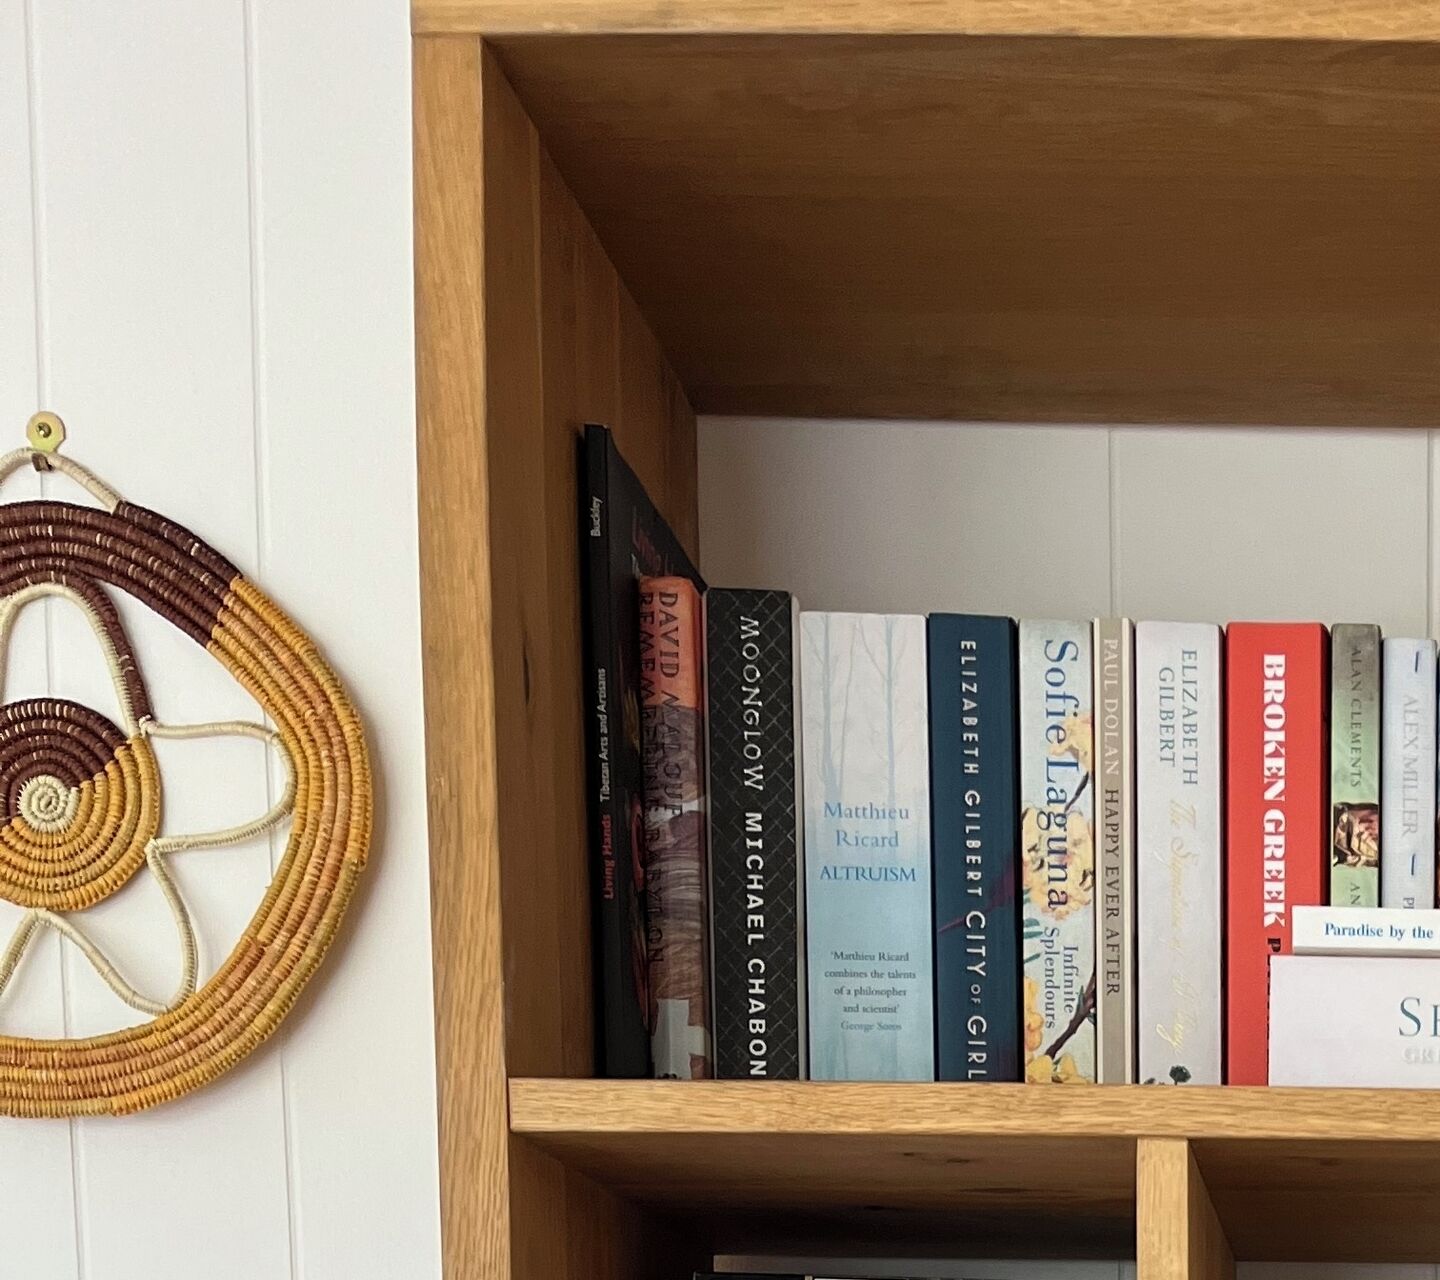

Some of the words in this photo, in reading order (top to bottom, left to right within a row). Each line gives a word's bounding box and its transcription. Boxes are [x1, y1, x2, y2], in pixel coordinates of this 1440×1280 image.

[740, 616, 764, 791] MOONGLOW
[1045, 638, 1078, 745] Sofie
[1103, 638, 1118, 690] PAUL
[960, 639, 979, 775] ELIZABETH
[1103, 695, 1119, 776] DOLAN
[1158, 667, 1175, 768] GILBERT
[1181, 648, 1199, 786] ELIZABETH
[1263, 654, 1287, 802] BROKEN
[824, 802, 910, 821] Matthieu
[836, 829, 900, 848] Ricard
[964, 790, 982, 896] GILBERT
[1036, 757, 1079, 909] Laguna
[1105, 789, 1120, 857] HAPPY
[745, 812, 765, 946] MICHAEL
[819, 865, 917, 882] ALTRUISM
[1105, 866, 1121, 919] EVER
[1263, 808, 1287, 928] GREEK
[966, 910, 986, 977] CITY
[1106, 927, 1122, 996] AFTER
[1324, 922, 1384, 938] Paradise
[1388, 924, 1405, 940] by
[1412, 925, 1434, 939] the
[824, 969, 867, 980] combines
[870, 969, 886, 979] the
[887, 969, 917, 980] talents
[971, 983, 982, 1004] OF
[1040, 926, 1060, 1030] Splendours
[1063, 945, 1079, 1014] Infinite
[748, 958, 767, 1076] CHABON
